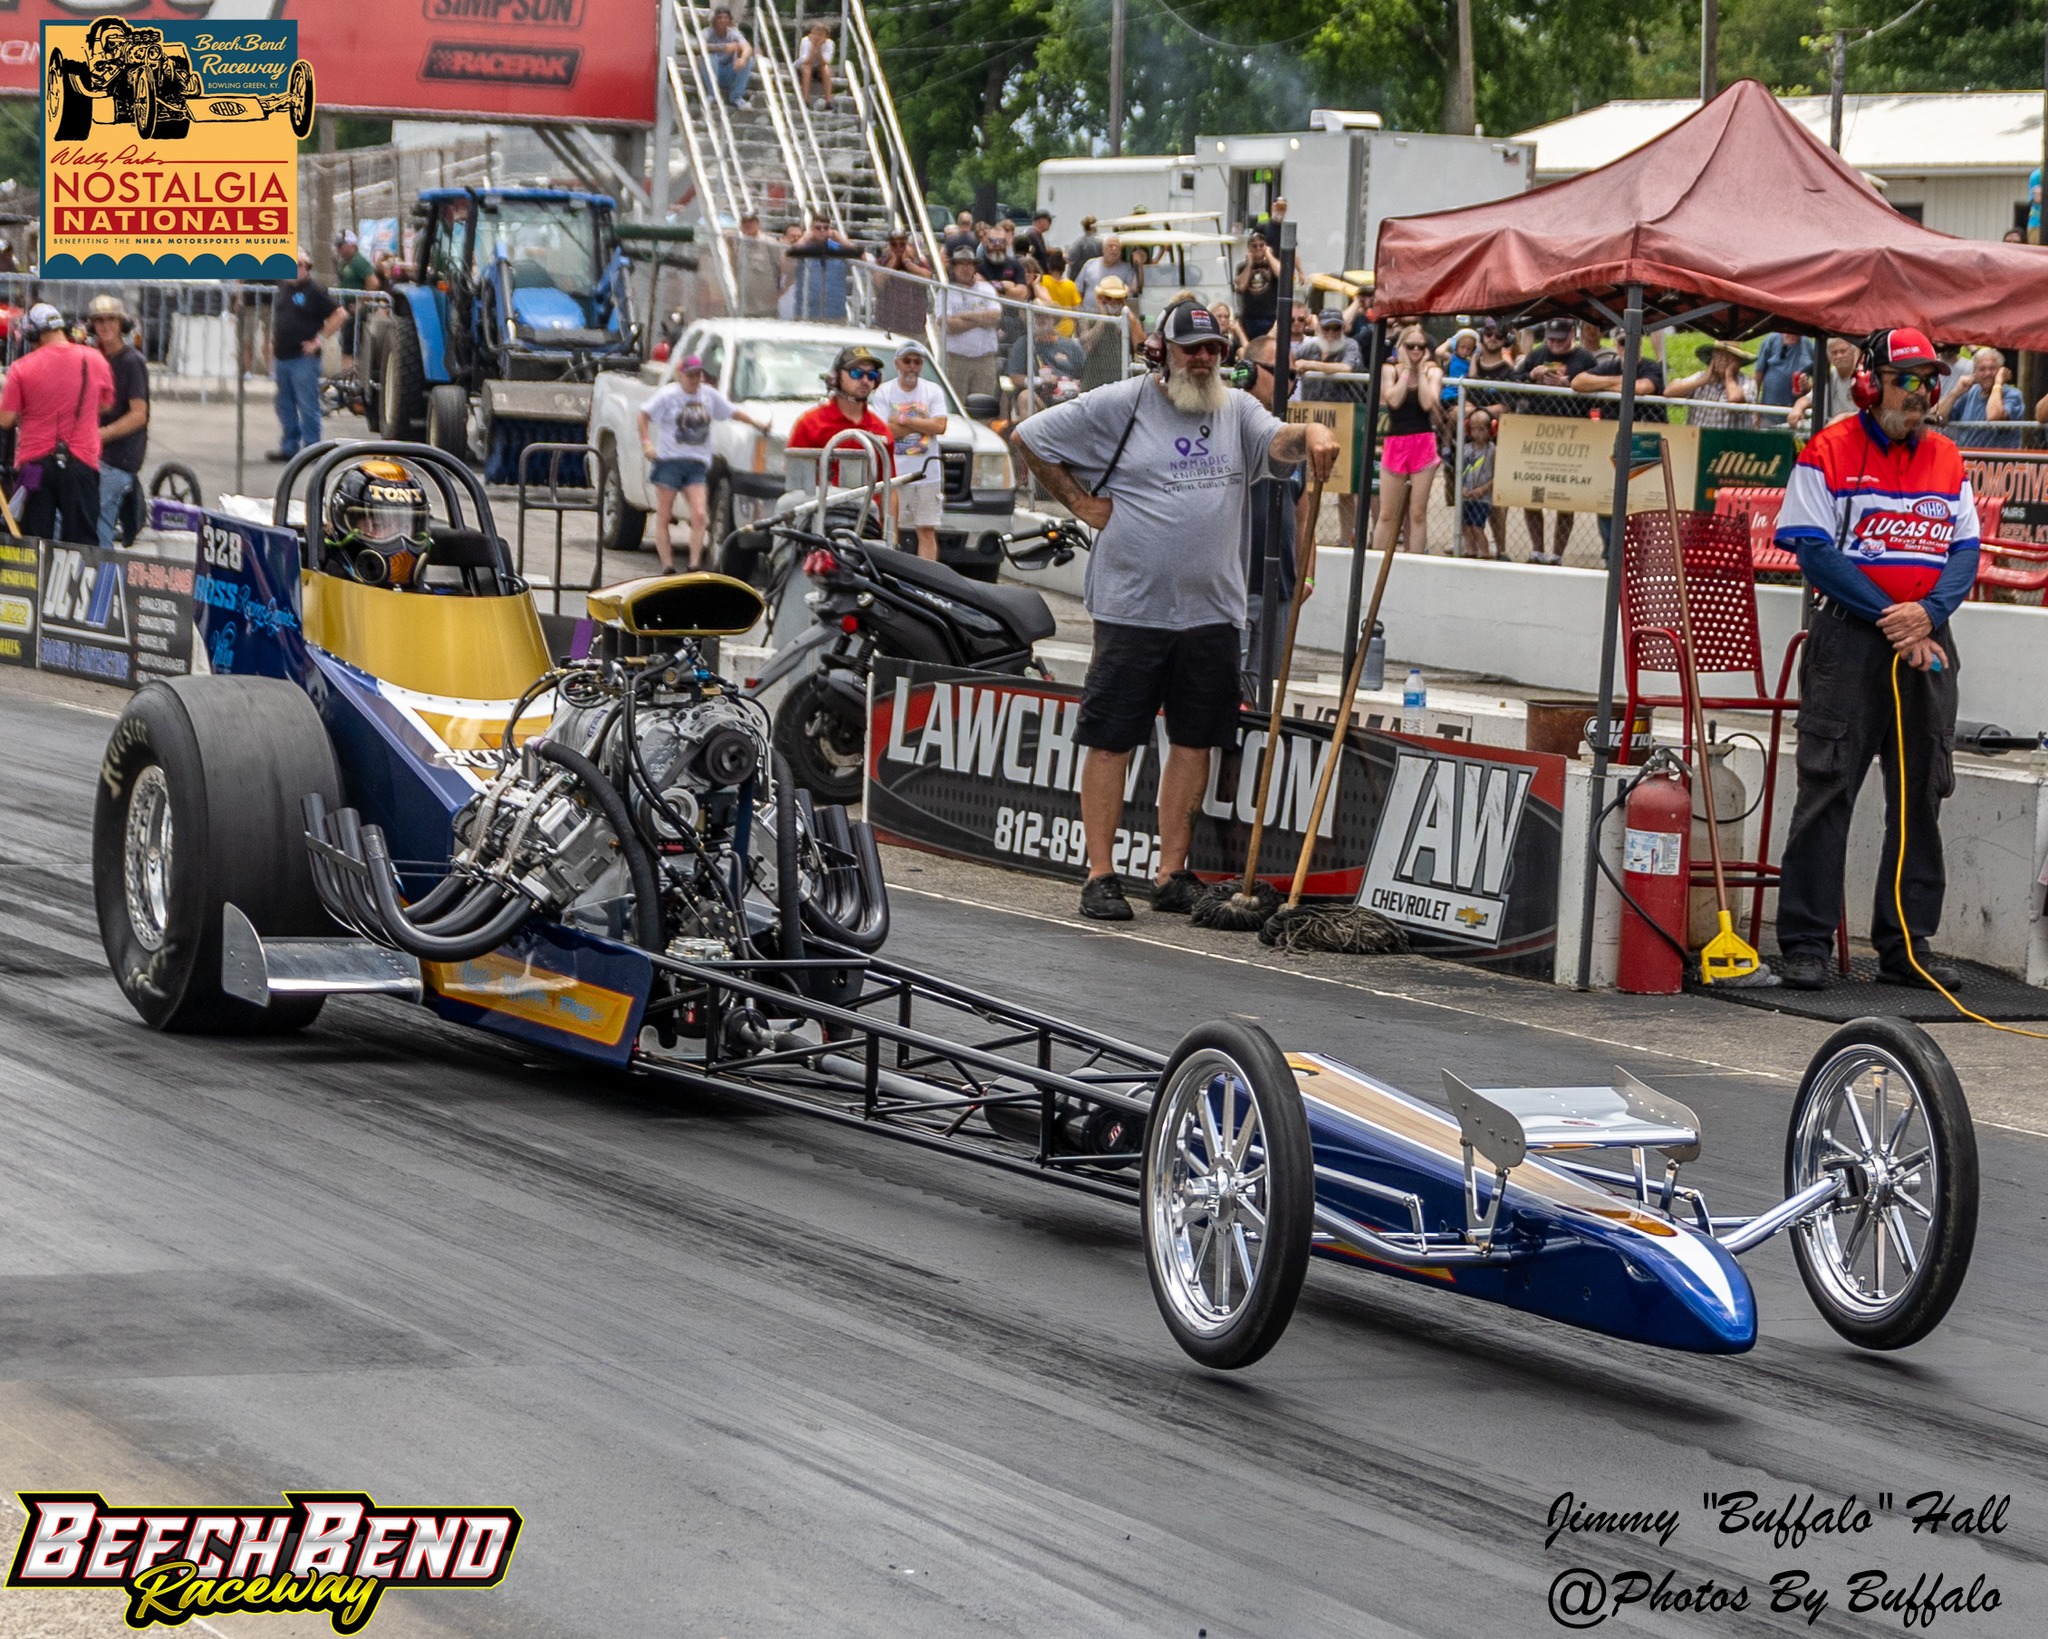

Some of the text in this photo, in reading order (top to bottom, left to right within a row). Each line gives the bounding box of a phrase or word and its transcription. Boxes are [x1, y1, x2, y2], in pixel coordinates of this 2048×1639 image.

[451, 51, 570, 78] RACEPAK
[1287, 408, 1337, 429] THE WIN
[1535, 423, 1578, 439] DON'T
[1520, 441, 1591, 459] MISS OUT!
[1169, 454, 1230, 471] NOMADIC
[1172, 464, 1232, 480] KNAPPERS
[1714, 450, 1782, 478] Mint
[1513, 471, 1593, 486] $1,000 FREE PLAY
[1964, 459, 2048, 503] TOMOTIVE
[368, 485, 423, 504] TONY
[1862, 517, 1955, 541] LUCAS OIL
[203, 524, 243, 572] 328
[1370, 887, 1451, 923] CHEVROLET
